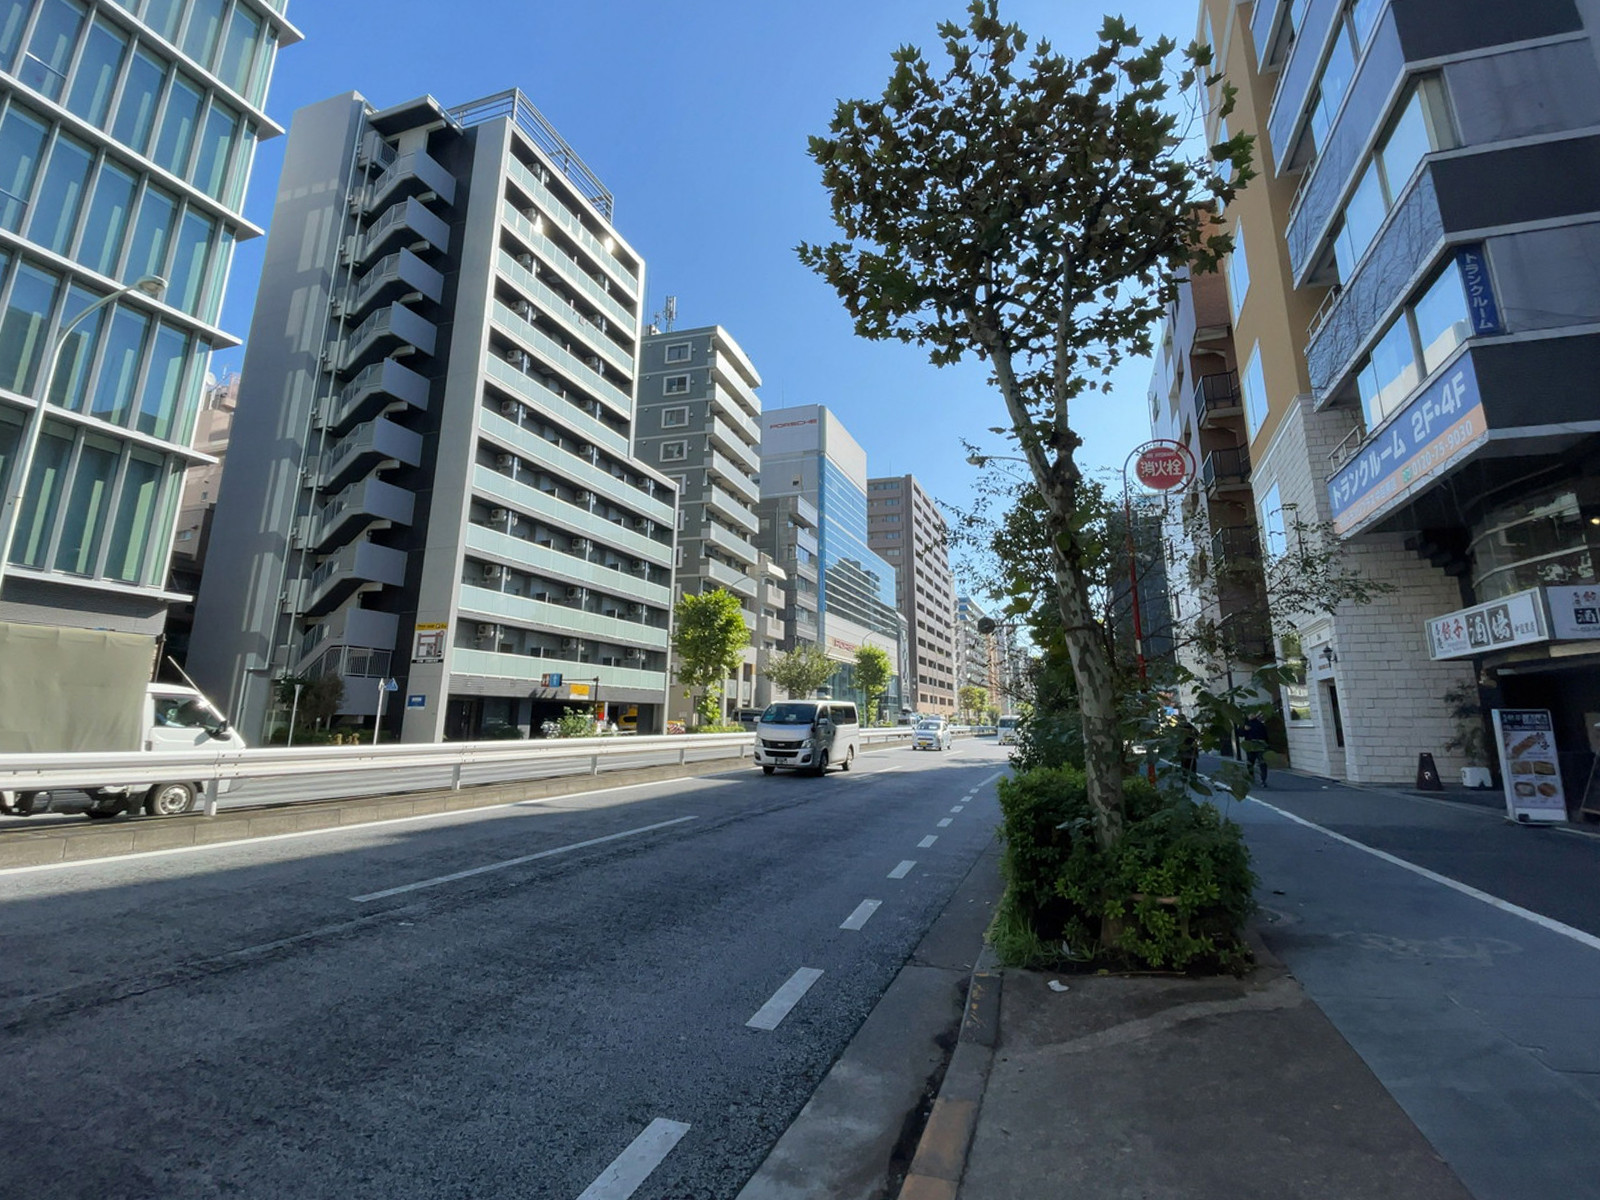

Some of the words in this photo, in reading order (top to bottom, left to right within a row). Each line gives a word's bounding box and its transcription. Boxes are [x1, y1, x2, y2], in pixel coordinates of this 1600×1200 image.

[1465, 253, 1494, 329] トランクルーム
[1140, 458, 1182, 477] 消火栓
[1332, 430, 1407, 509] トランクルーム
